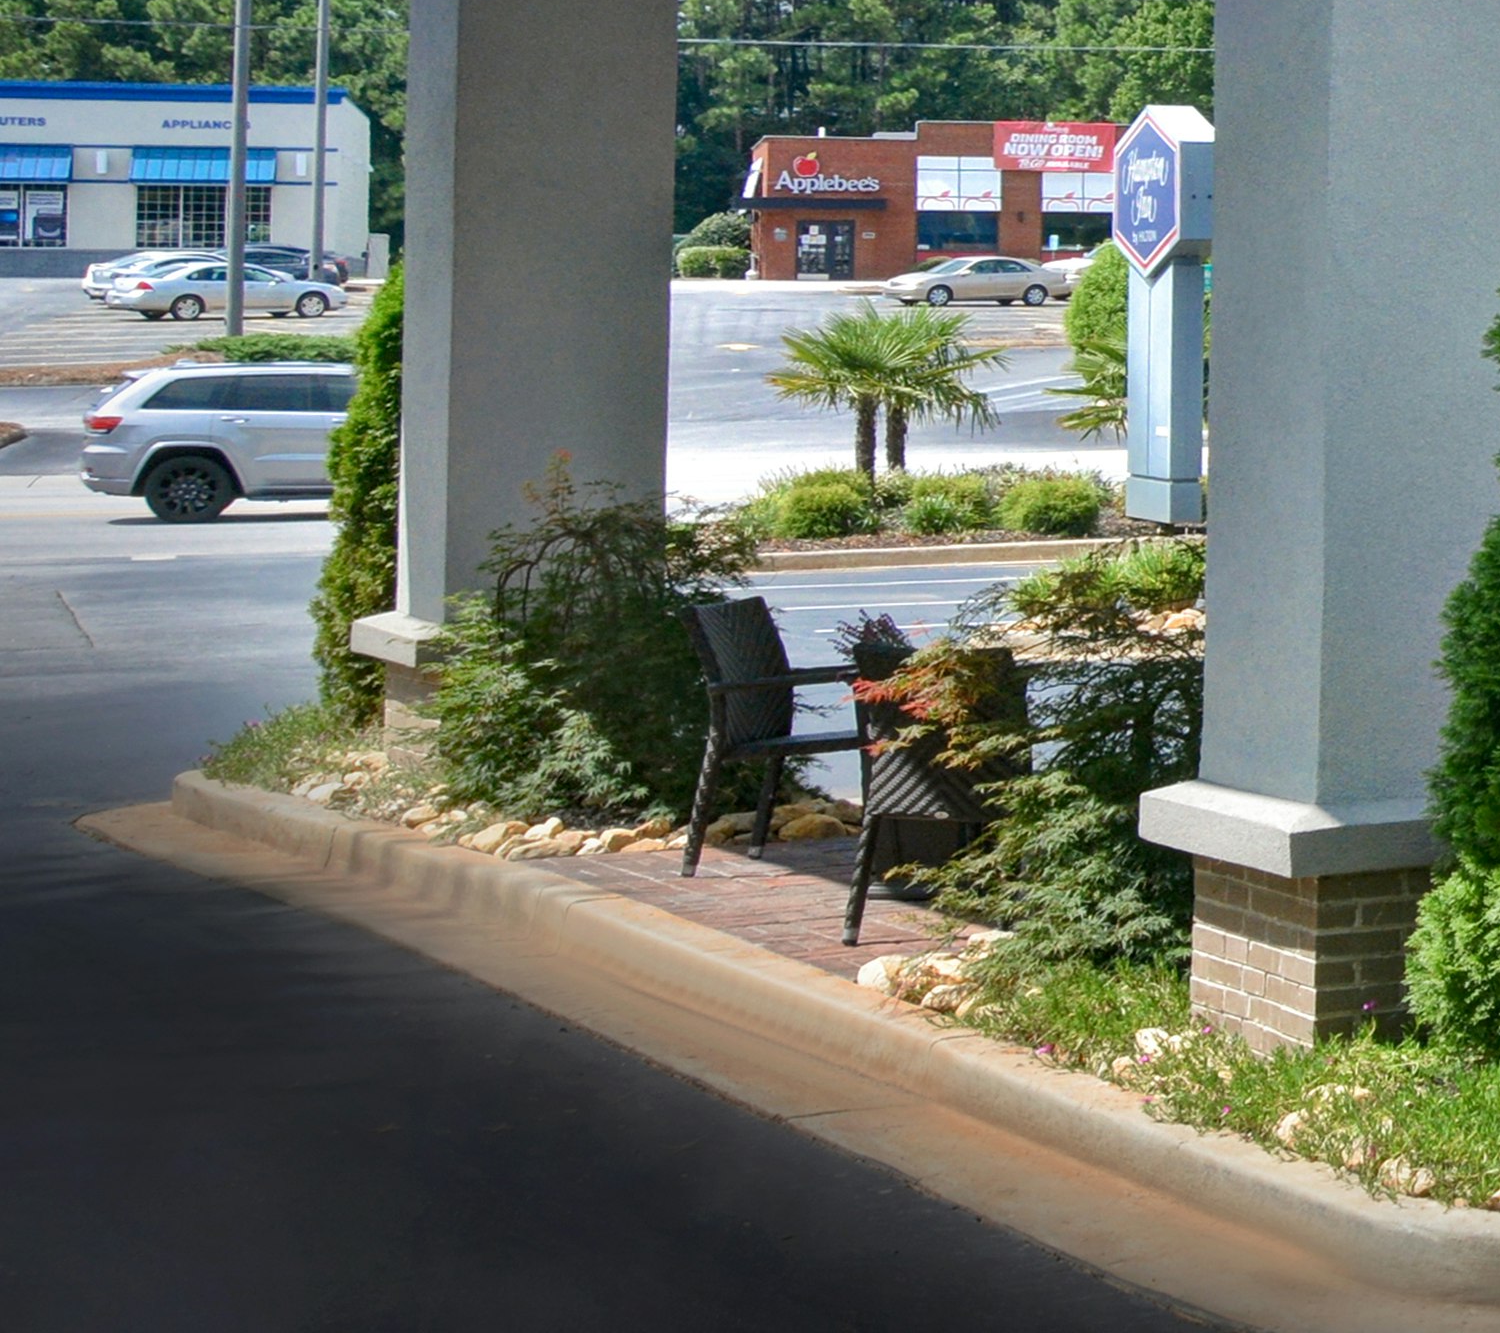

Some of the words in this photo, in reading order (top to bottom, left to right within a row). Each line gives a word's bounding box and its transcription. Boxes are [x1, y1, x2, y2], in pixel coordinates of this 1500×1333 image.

[0, 116, 46, 127] UTERS
[162, 119, 251, 131] APPLIANCS
[1010, 133, 1057, 144] DINING
[1058, 134, 1098, 145] ROOM
[1003, 142, 1049, 156] NOW
[1050, 145, 1104, 158] OPEN!
[774, 170, 880, 194] Applebee's
